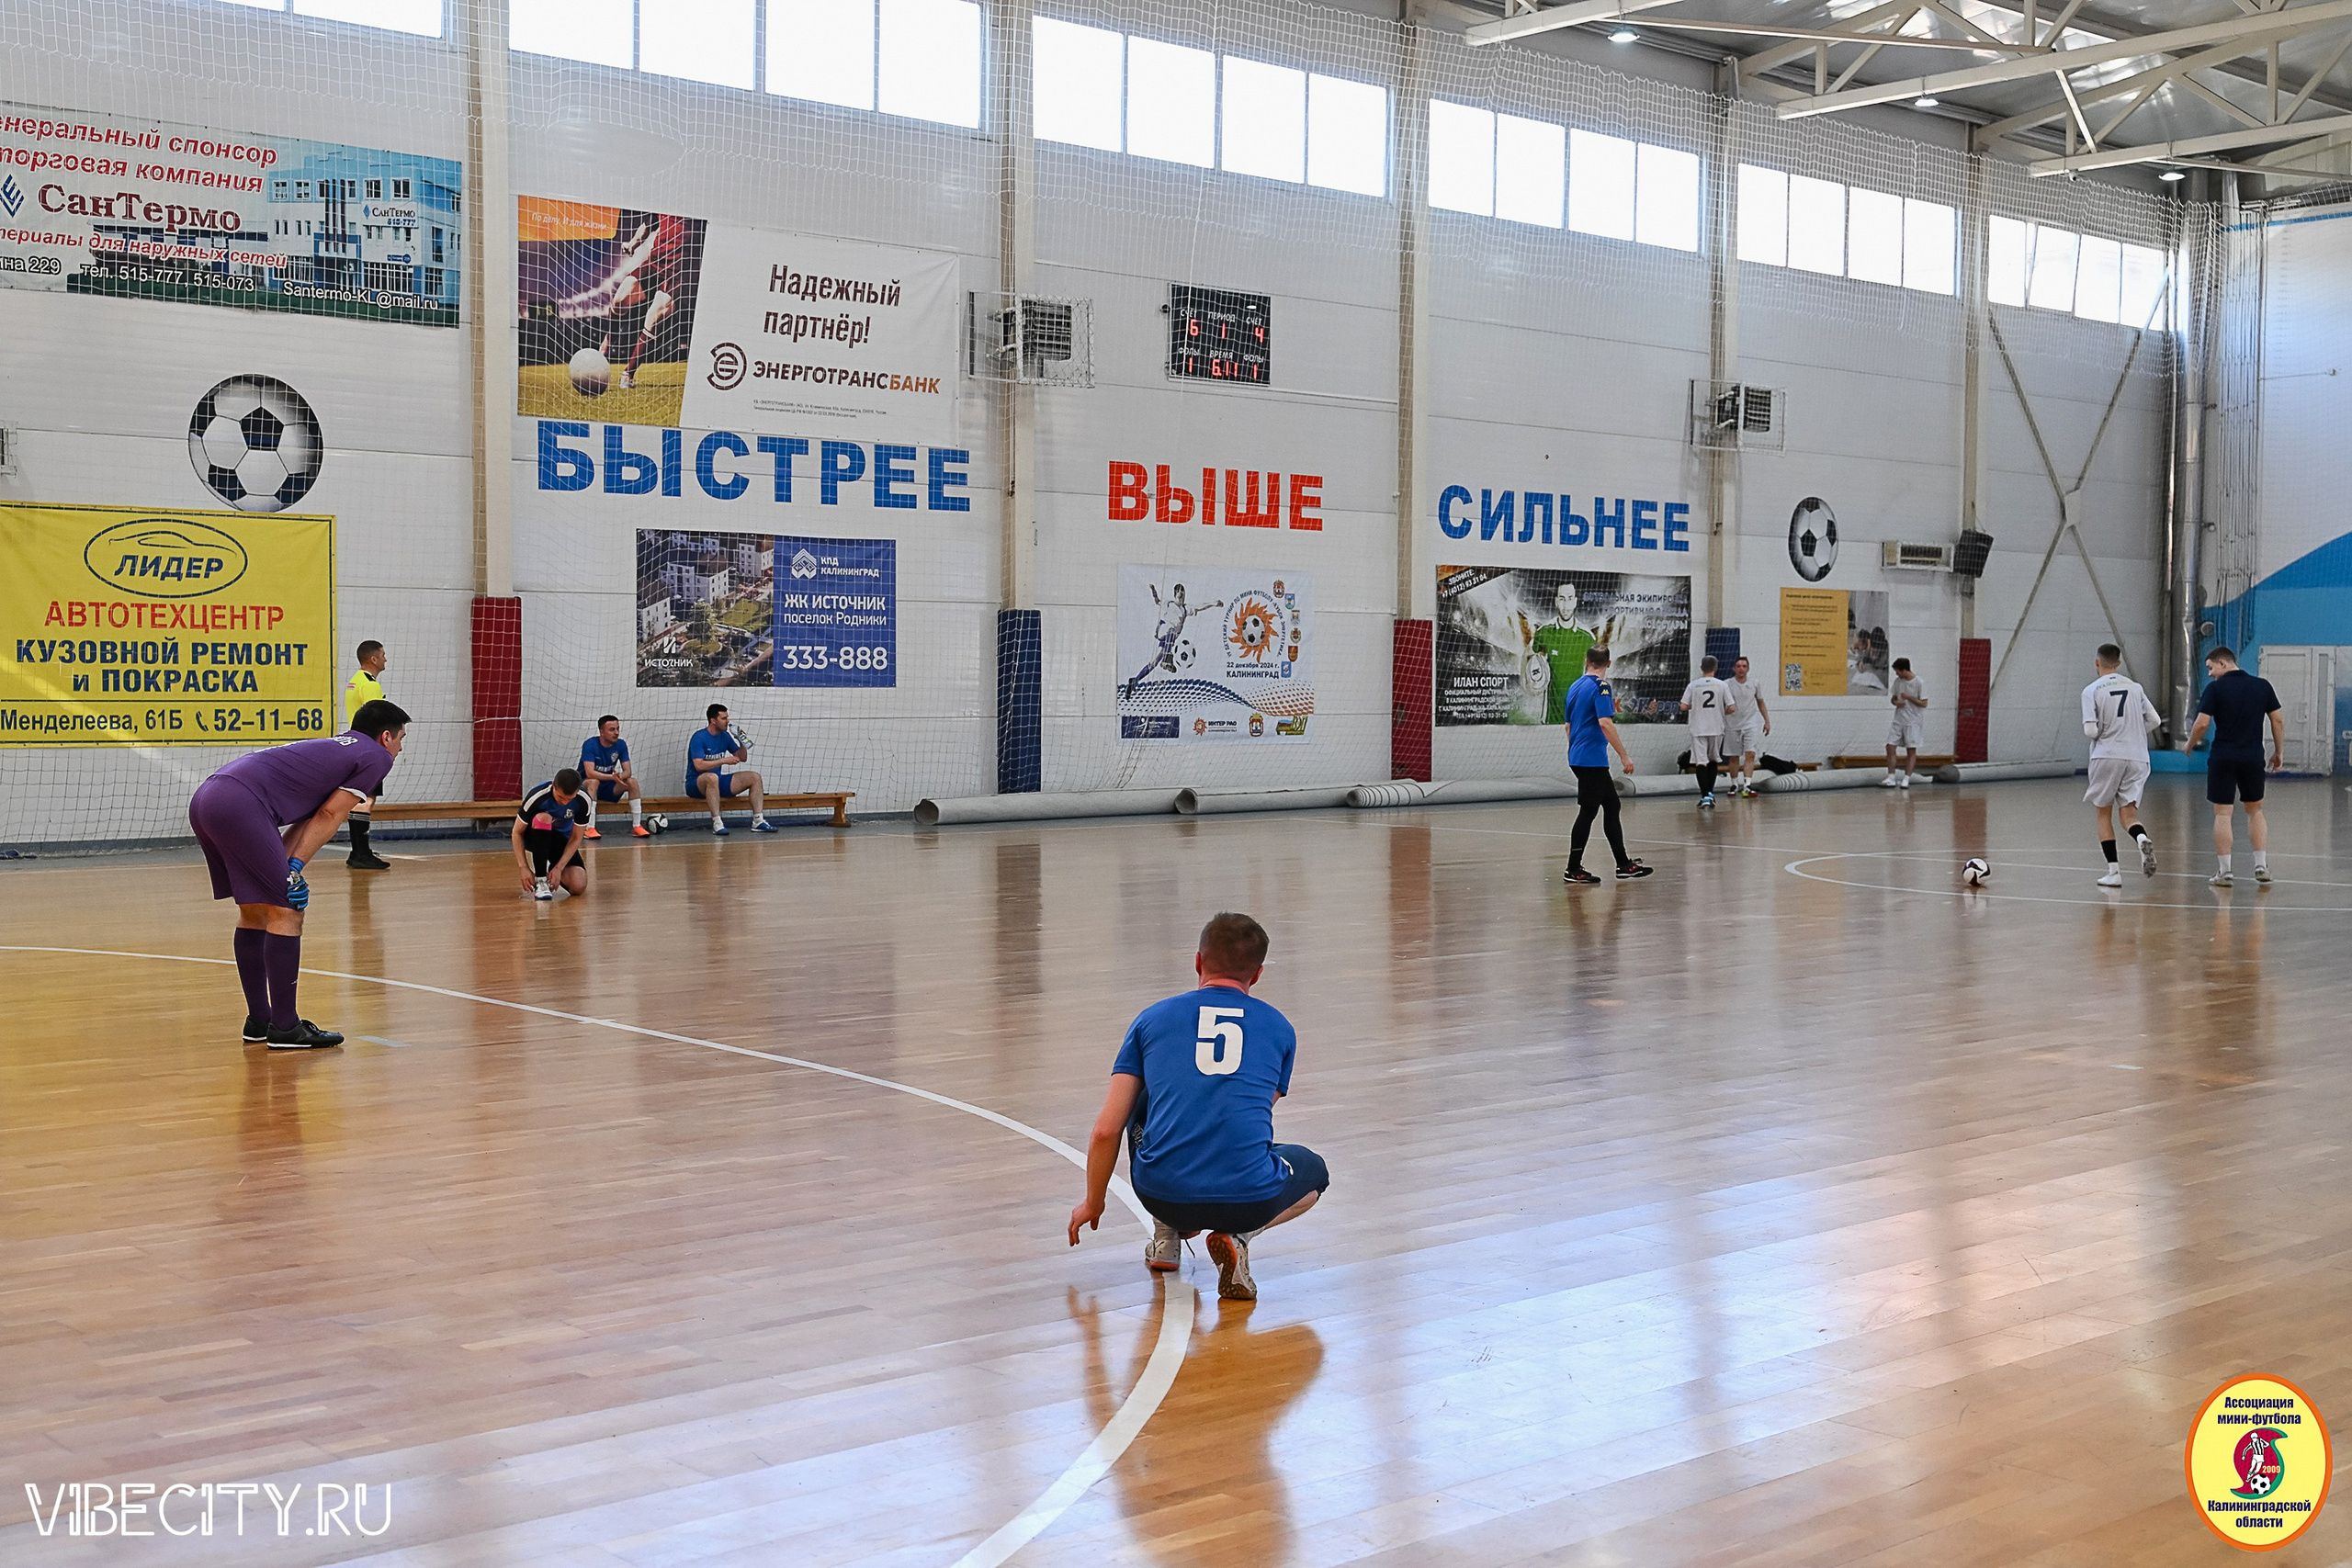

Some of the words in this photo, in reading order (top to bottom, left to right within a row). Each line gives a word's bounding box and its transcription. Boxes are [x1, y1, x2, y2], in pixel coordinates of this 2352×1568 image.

[0, 116, 160, 150] неральный
[169, 137, 277, 169] спонсор
[136, 164, 263, 193] компания
[39, 184, 241, 232] СанТермо
[89, 233, 125, 251] для
[130, 239, 225, 261] наружных
[230, 250, 288, 267] сетей
[29, 256, 61, 274] 229
[82, 265, 113, 278] тел.
[119, 266, 187, 288] 515-777,
[193, 273, 254, 291] 515-073
[283, 280, 438, 310] Santermo-KL@mail.ru
[769, 264, 901, 307] Надежный
[763, 309, 871, 348] партнёр!
[1207, 311, 1236, 322] ПЕРИОД
[1254, 327, 1264, 344] 4
[1210, 350, 1233, 359] ВРЕМЯ
[753, 360, 941, 395] ЭНЕРГОТРАНСБАНК
[537, 420, 970, 512] БЫСТРЕЕ
[1108, 460, 1323, 531] ВЫШЕ
[1438, 484, 1690, 551] СИЛЬНЕЕ
[114, 555, 224, 581] ЛИДЕР
[820, 557, 839, 566] КПД
[820, 568, 879, 578] КАЛИНИНГРАД
[785, 593, 808, 609] ЖК
[812, 594, 886, 611] ИСТОЧНИК
[44, 600, 285, 634] АВТОТЕХЦЕНТР
[784, 613, 832, 626] поселок
[836, 613, 887, 626] Родники
[17, 637, 179, 665] КУЗОВНОЙ
[191, 642, 308, 666] РЕМОНТ
[783, 645, 888, 671] 333-888
[73, 673, 90, 692] и
[101, 670, 259, 693] ПОКРАСКА
[1227, 671, 1279, 679] КАЛИНИНГРАД
[1453, 677, 1478, 687] ИЛАН
[1480, 676, 1509, 688] СПОРТ
[1702, 691, 1715, 708] 2
[2109, 690, 2128, 716] 7
[1, 709, 138, 734] Менделеева,
[145, 709, 183, 730] 61Б
[214, 708, 323, 731] 52-11-68
[1195, 1005, 1245, 1076] 5
